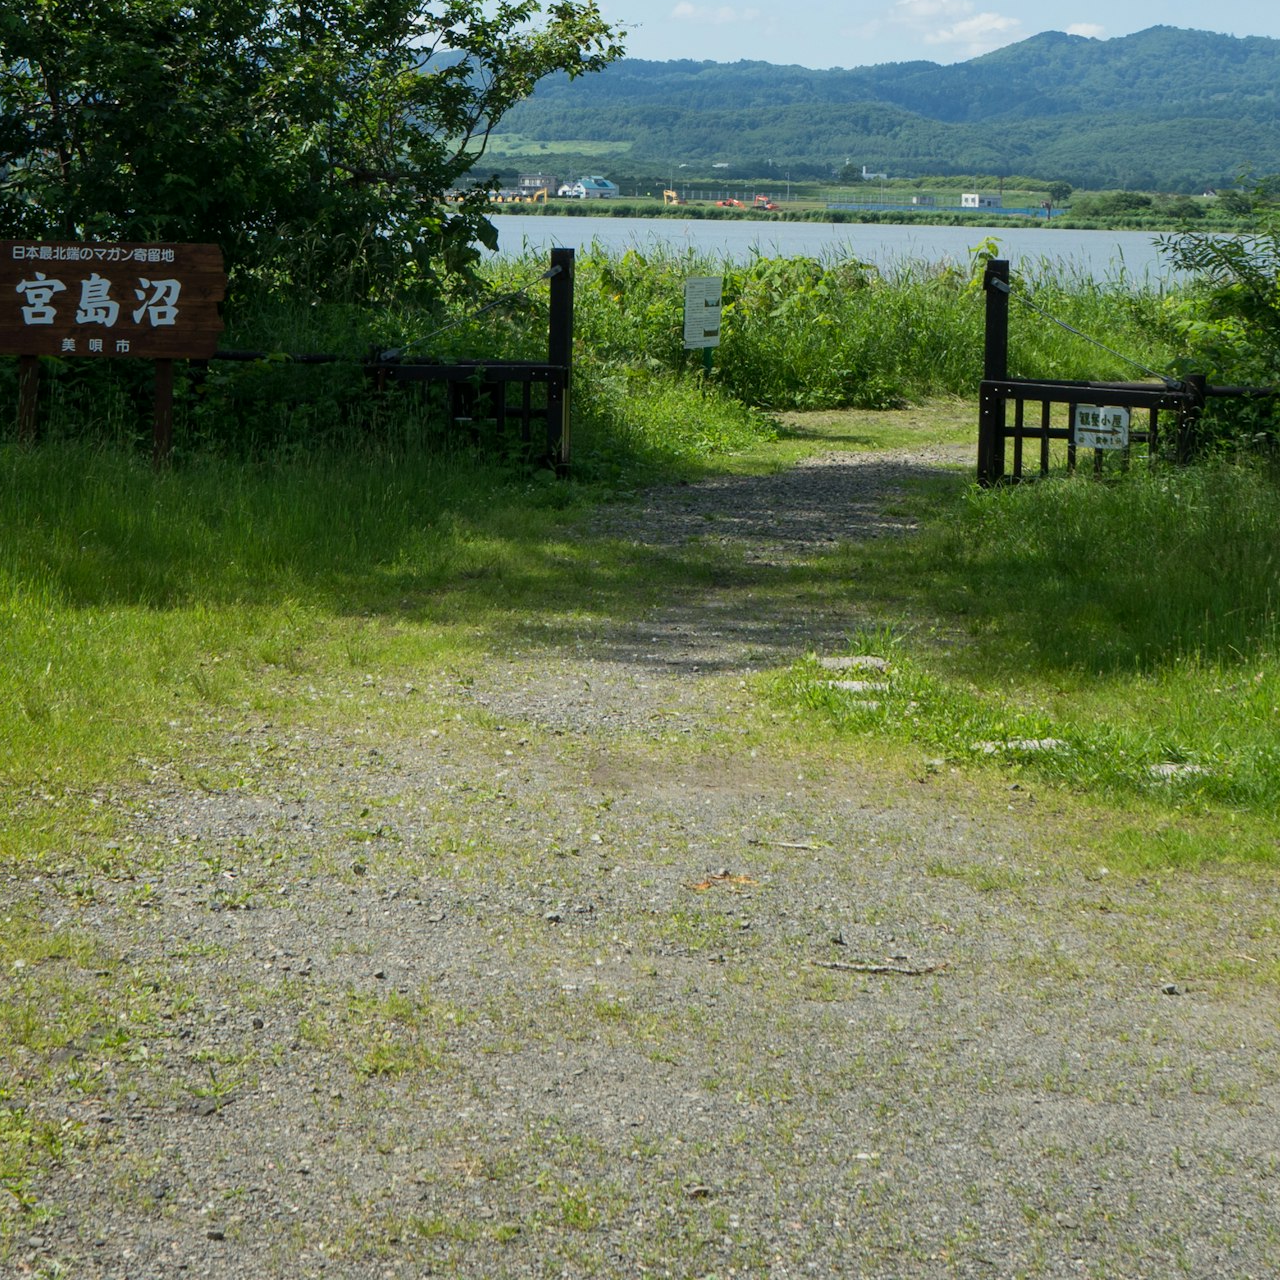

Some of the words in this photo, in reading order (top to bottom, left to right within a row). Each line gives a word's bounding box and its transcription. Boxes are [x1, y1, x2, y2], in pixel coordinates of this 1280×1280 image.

[12, 245, 175, 263] 日本最北端のマガン寄留地
[15, 271, 182, 328] 宮島沼
[61, 337, 131, 353] 美唄市
[1079, 411, 1123, 428] 観察小屋
